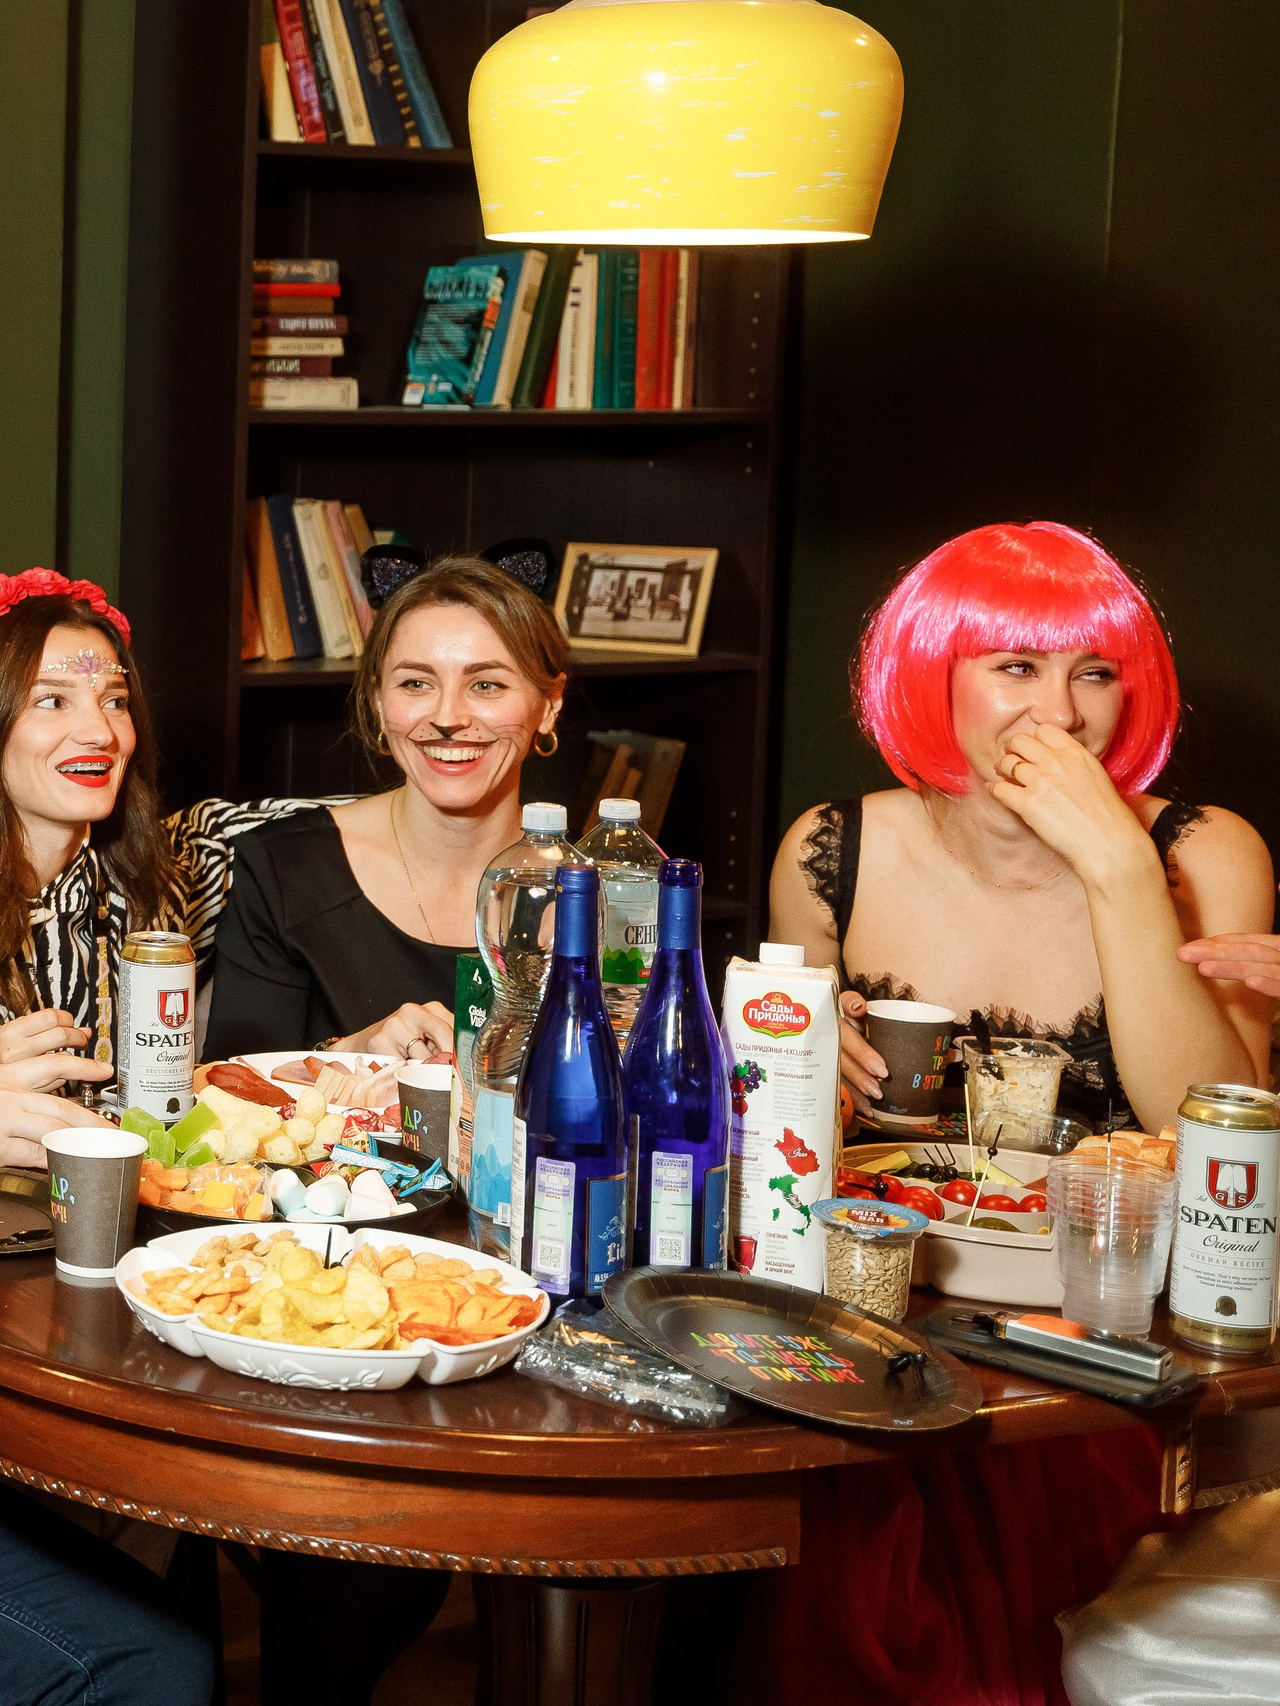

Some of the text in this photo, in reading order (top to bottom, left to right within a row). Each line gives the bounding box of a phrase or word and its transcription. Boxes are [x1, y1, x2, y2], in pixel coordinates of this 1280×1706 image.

[761, 1000, 794, 1014] Сады
[748, 1008, 806, 1024] Придонья
[136, 1030, 193, 1048] SPATE
[934, 1036, 942, 1052] Я
[736, 1042, 751, 1050] САДЫ
[752, 1045, 782, 1054] ПРИДОНЬЯ
[156, 1050, 190, 1066] Original
[912, 1073, 922, 1088] В
[1216, 1192, 1247, 1204] G S
[850, 1209, 878, 1218] MIX
[858, 1216, 884, 1224] BAR
[1180, 1205, 1278, 1234] SPATEN
[1202, 1234, 1260, 1254] Original
[1191, 1252, 1227, 1265] GERMAN
[690, 1332, 833, 1350] ДАВАЙТЕ УЖЕ
[710, 1348, 855, 1368] ЧТО-НИБУДЬ
[748, 1366, 865, 1383] ОТМЕТИМ?
